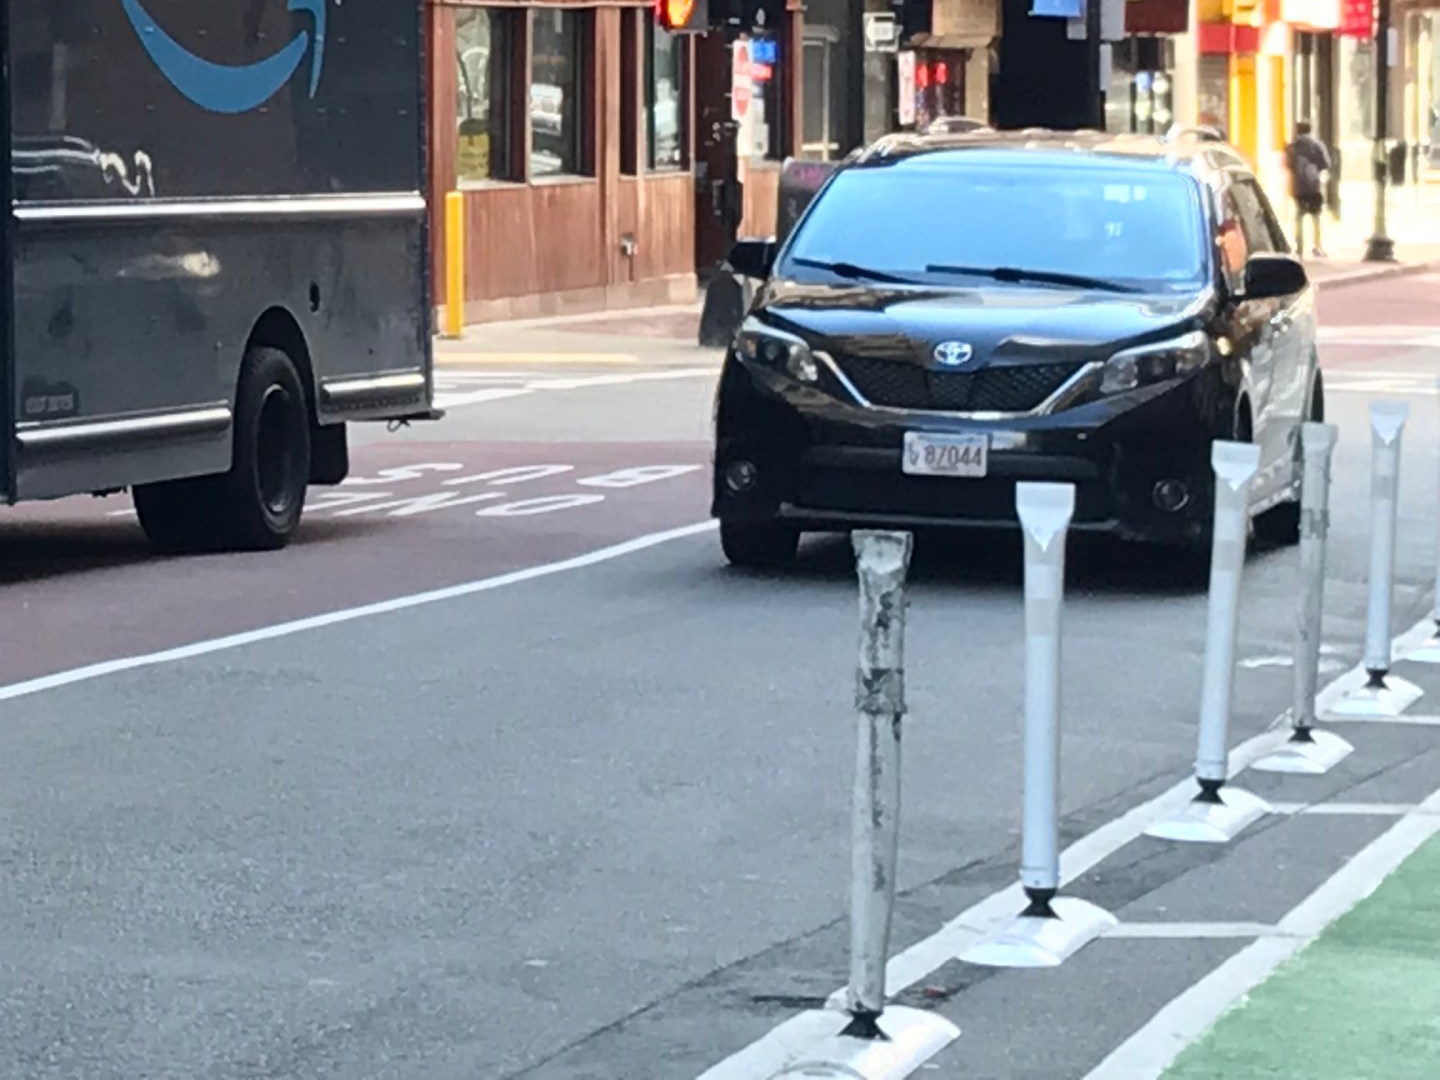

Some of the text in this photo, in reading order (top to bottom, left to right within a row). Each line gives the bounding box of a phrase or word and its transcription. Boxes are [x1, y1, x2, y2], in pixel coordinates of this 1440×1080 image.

[923, 444, 982, 468] 87044
[343, 462, 704, 488] BUS
[303, 492, 606, 518] ONL
